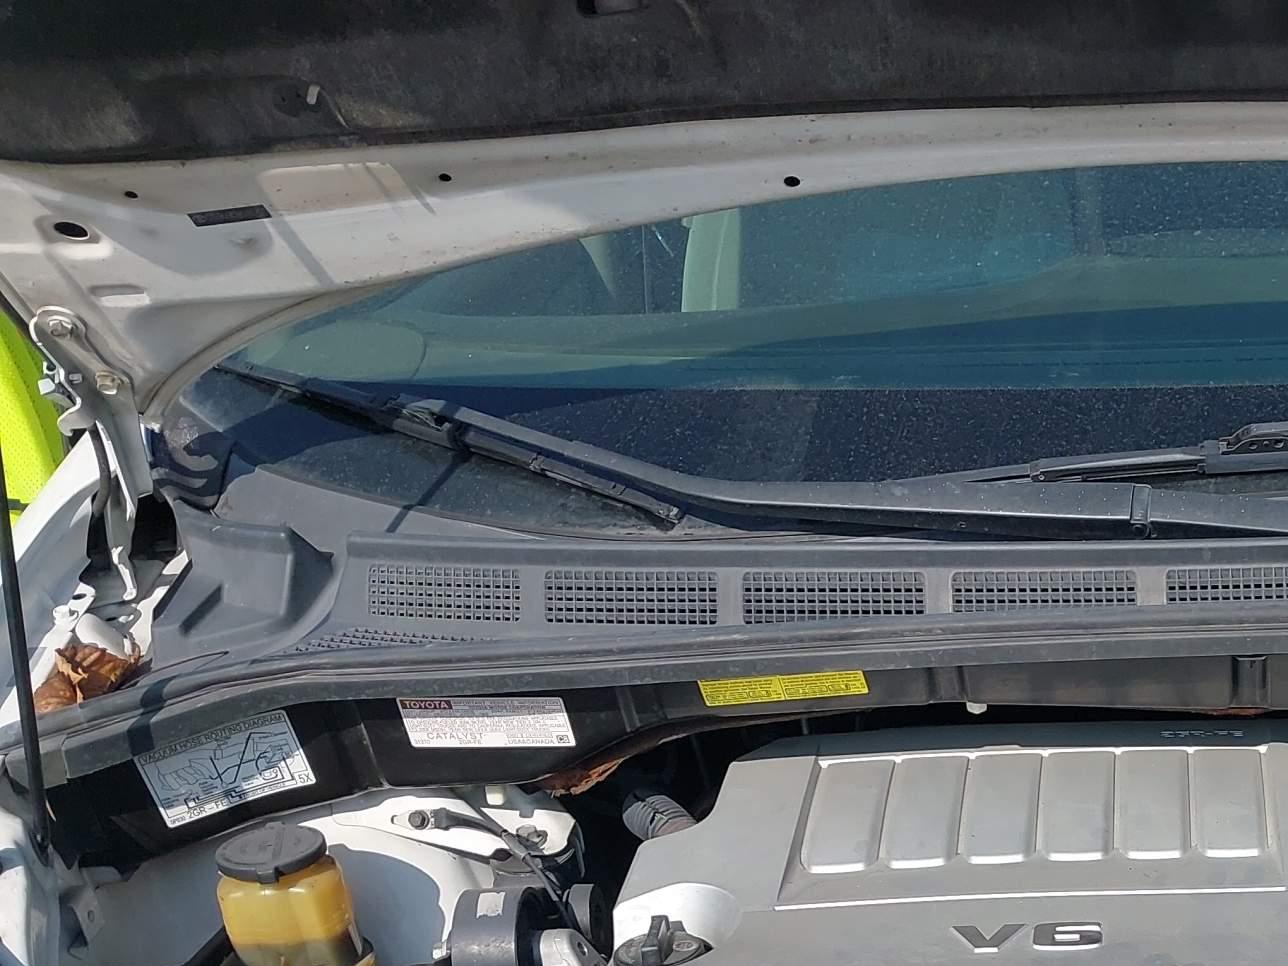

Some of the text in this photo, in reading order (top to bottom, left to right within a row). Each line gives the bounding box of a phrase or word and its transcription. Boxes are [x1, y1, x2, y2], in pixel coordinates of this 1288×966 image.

[404, 701, 449, 709] TOYOTA
[179, 736, 204, 749] HOSE
[204, 723, 243, 742] ROUTING
[244, 714, 283, 731] DIAGRAM
[426, 732, 484, 740] CATALYST
[299, 773, 313, 784] 5X
[951, 921, 1104, 953] V6
